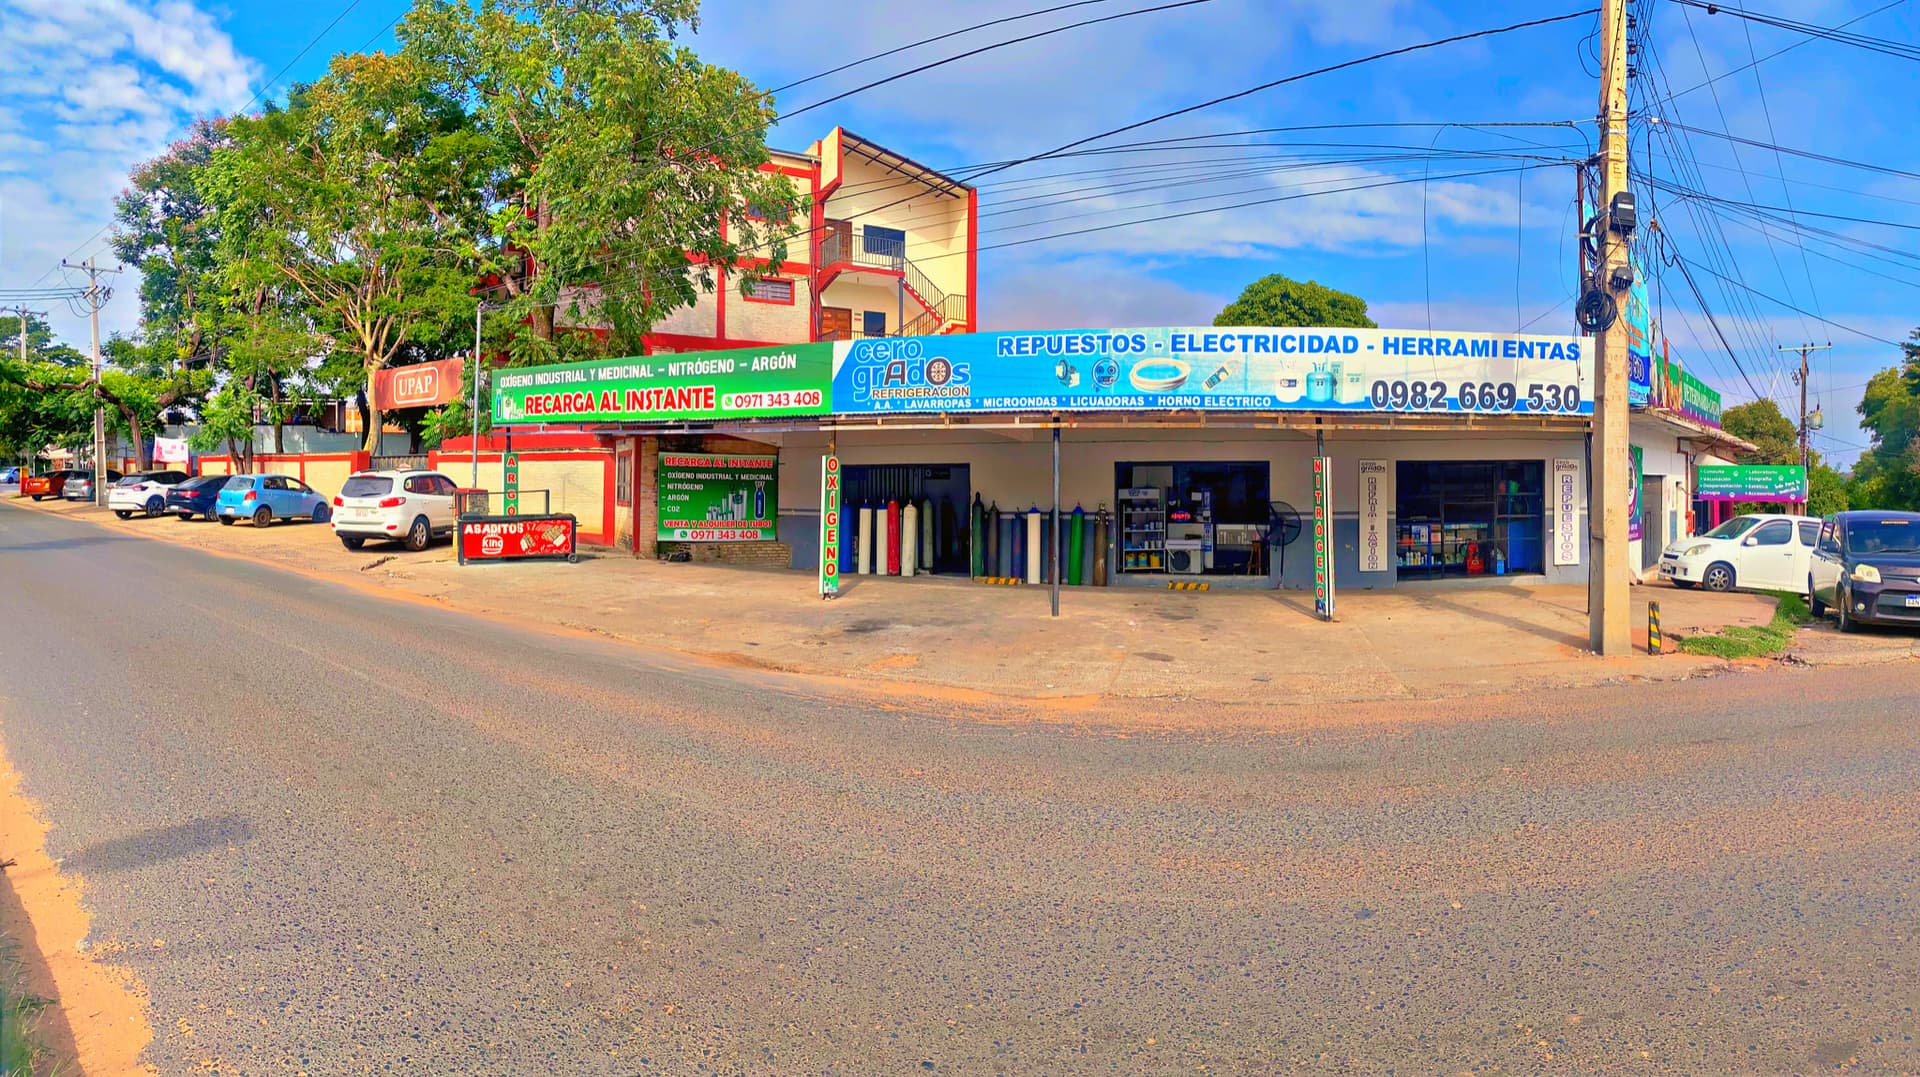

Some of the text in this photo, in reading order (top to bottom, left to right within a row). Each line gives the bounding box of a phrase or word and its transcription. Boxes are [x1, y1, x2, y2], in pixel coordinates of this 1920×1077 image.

[855, 339, 923, 362] cero
[997, 334, 1146, 357] REPUESTOS
[1170, 332, 1359, 354] ELECTRICIDAD
[1382, 336, 1581, 362] HERRAMIENTAS
[500, 373, 533, 388] OXÍGENO
[535, 369, 587, 386] INDUSTRIAL
[590, 368, 598, 381] Y
[598, 363, 654, 380] MEDICINAL
[668, 354, 735, 377] NITRÓGENO
[751, 350, 797, 372] ARGÓN
[399, 374, 433, 397] UPAP
[1371, 380, 1580, 412] 0982 669 530
[525, 386, 715, 414] RECARGA AL INSTANTE
[734, 391, 820, 409] 0971 343 408
[874, 395, 1271, 410] A.A. LAVARROPAS MICROONDAS LICUADORAS HORNO ELECTRICO
[665, 456, 773, 468] RECARGA AL INSTANTE
[506, 455, 517, 516] ARGÓ
[667, 471, 695, 480] OXÍGENO
[696, 472, 734, 480] INDUSTRIAL
[740, 473, 774, 481] MEDICINAL
[667, 481, 704, 490] NITRÓGENO
[667, 493, 690, 501] ARGÓN
[664, 520, 689, 528] VENTA
[691, 520, 697, 528] Y
[698, 520, 736, 528] ALQUILER
[738, 520, 748, 528] DE
[825, 456, 839, 577] OXÍGENO
[1561, 474, 1573, 561] REPUESTOS
[691, 530, 759, 540] 0971 343 408
